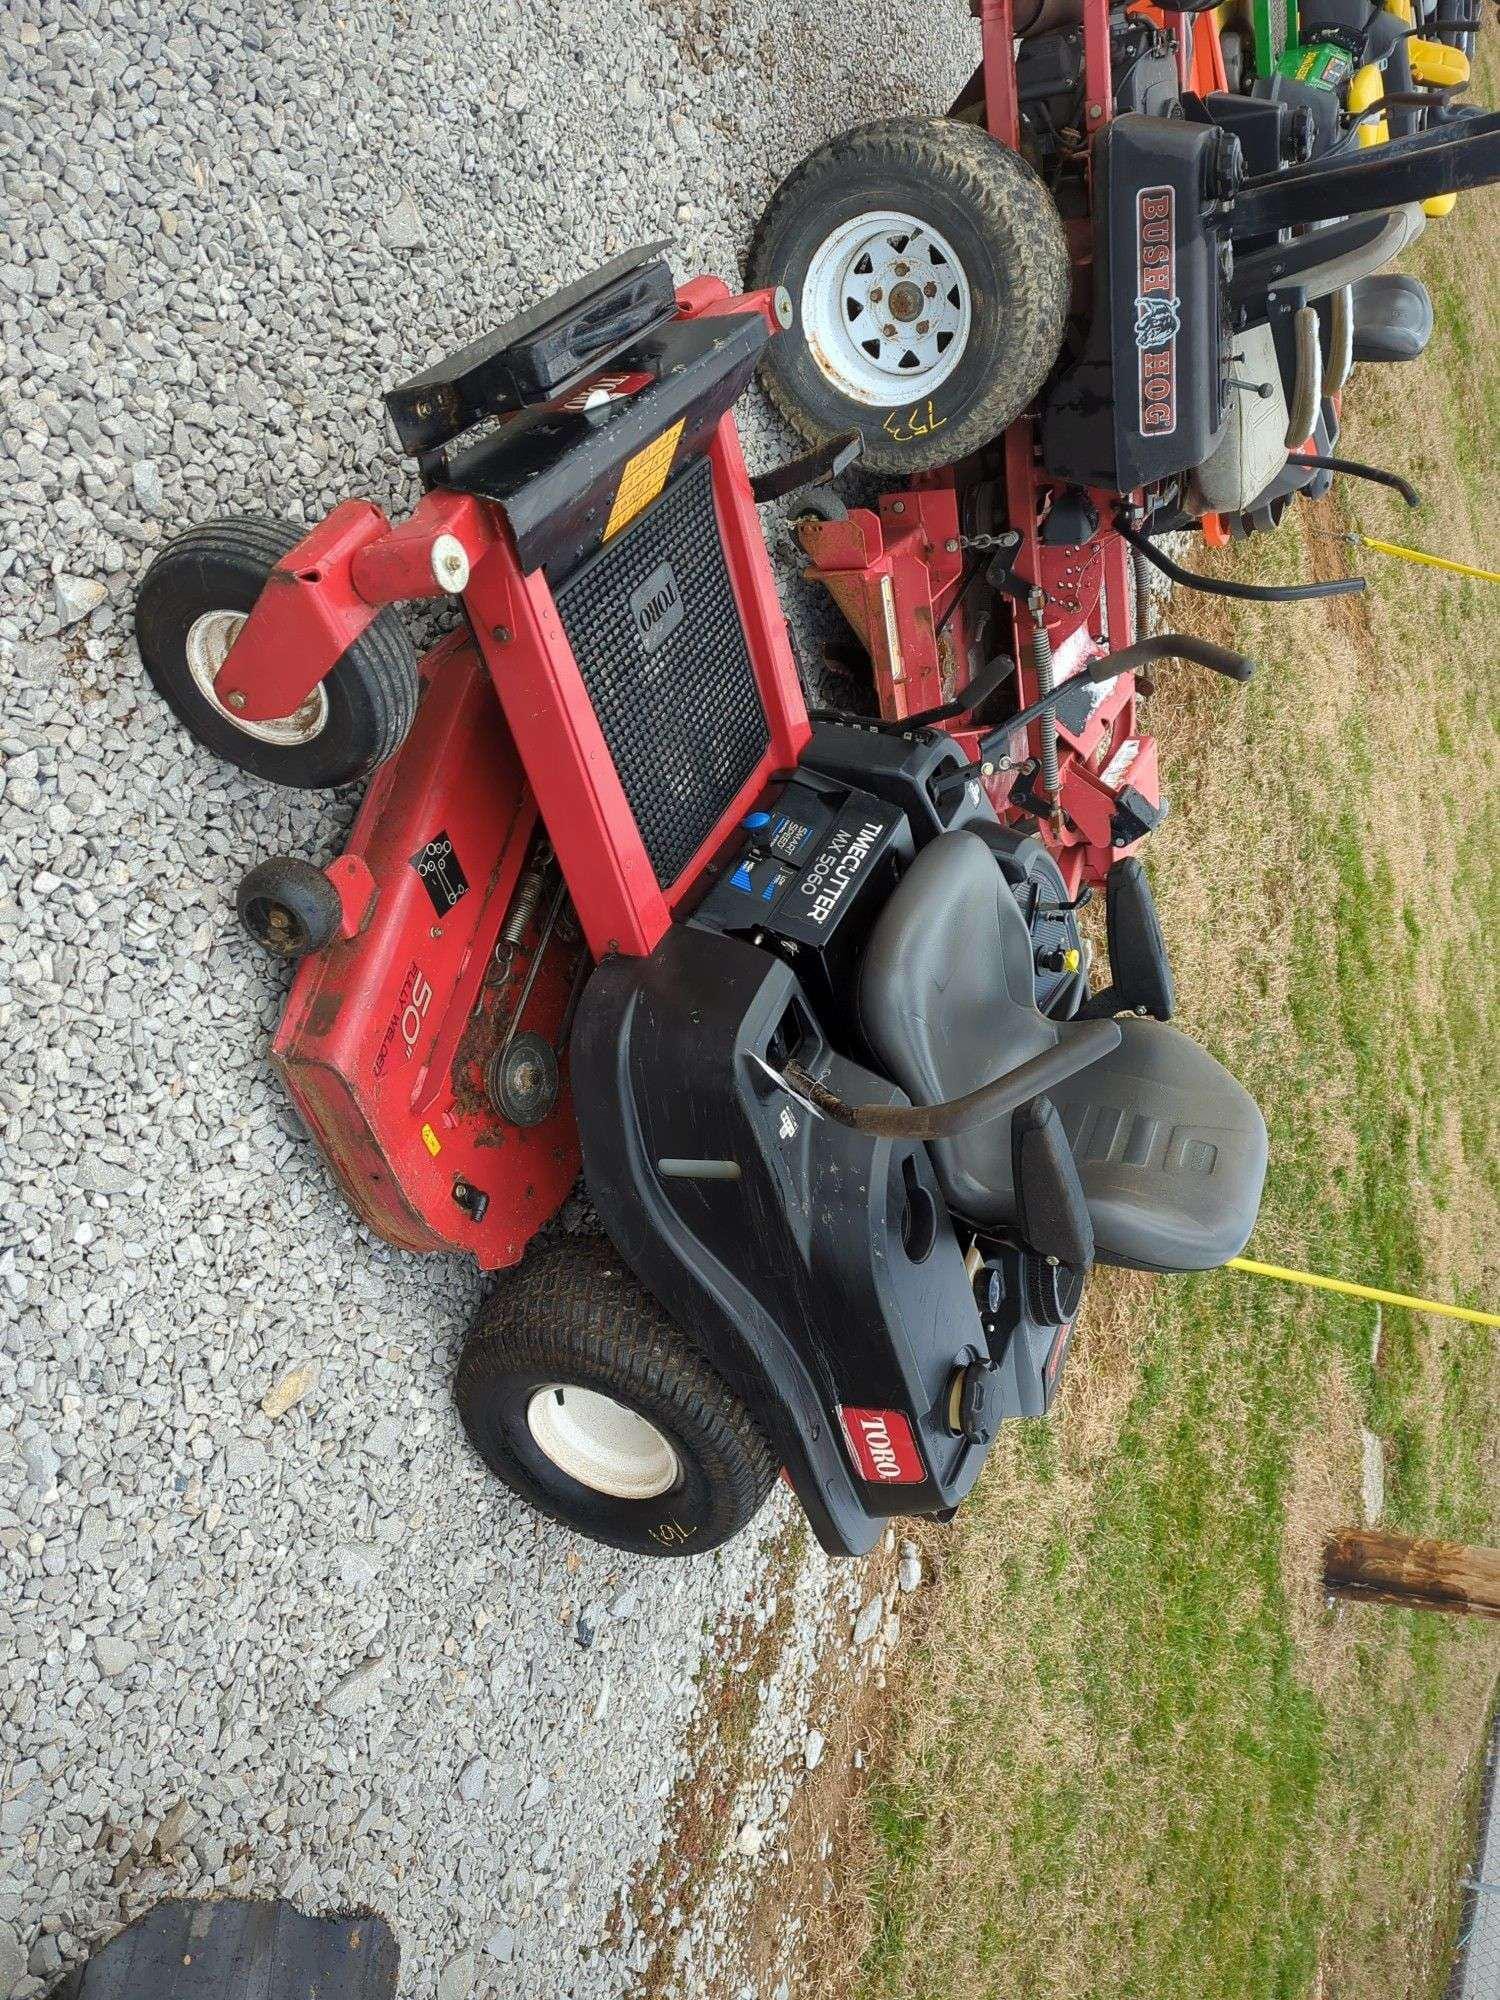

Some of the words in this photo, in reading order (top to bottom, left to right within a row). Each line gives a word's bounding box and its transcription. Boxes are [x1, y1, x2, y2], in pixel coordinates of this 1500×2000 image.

[1142, 195, 1170, 293] BUSH
[1144, 351, 1171, 426] HOG
[883, 400, 948, 441] 753
[638, 582, 678, 633] TORO
[777, 821, 798, 848] SPEED
[784, 825, 808, 856] SMART
[825, 829, 852, 851] MX
[800, 853, 836, 895] 5060
[807, 822, 883, 923] TIMECUTTER
[398, 961, 419, 1005] FULLY
[860, 1417, 901, 1479] TORO
